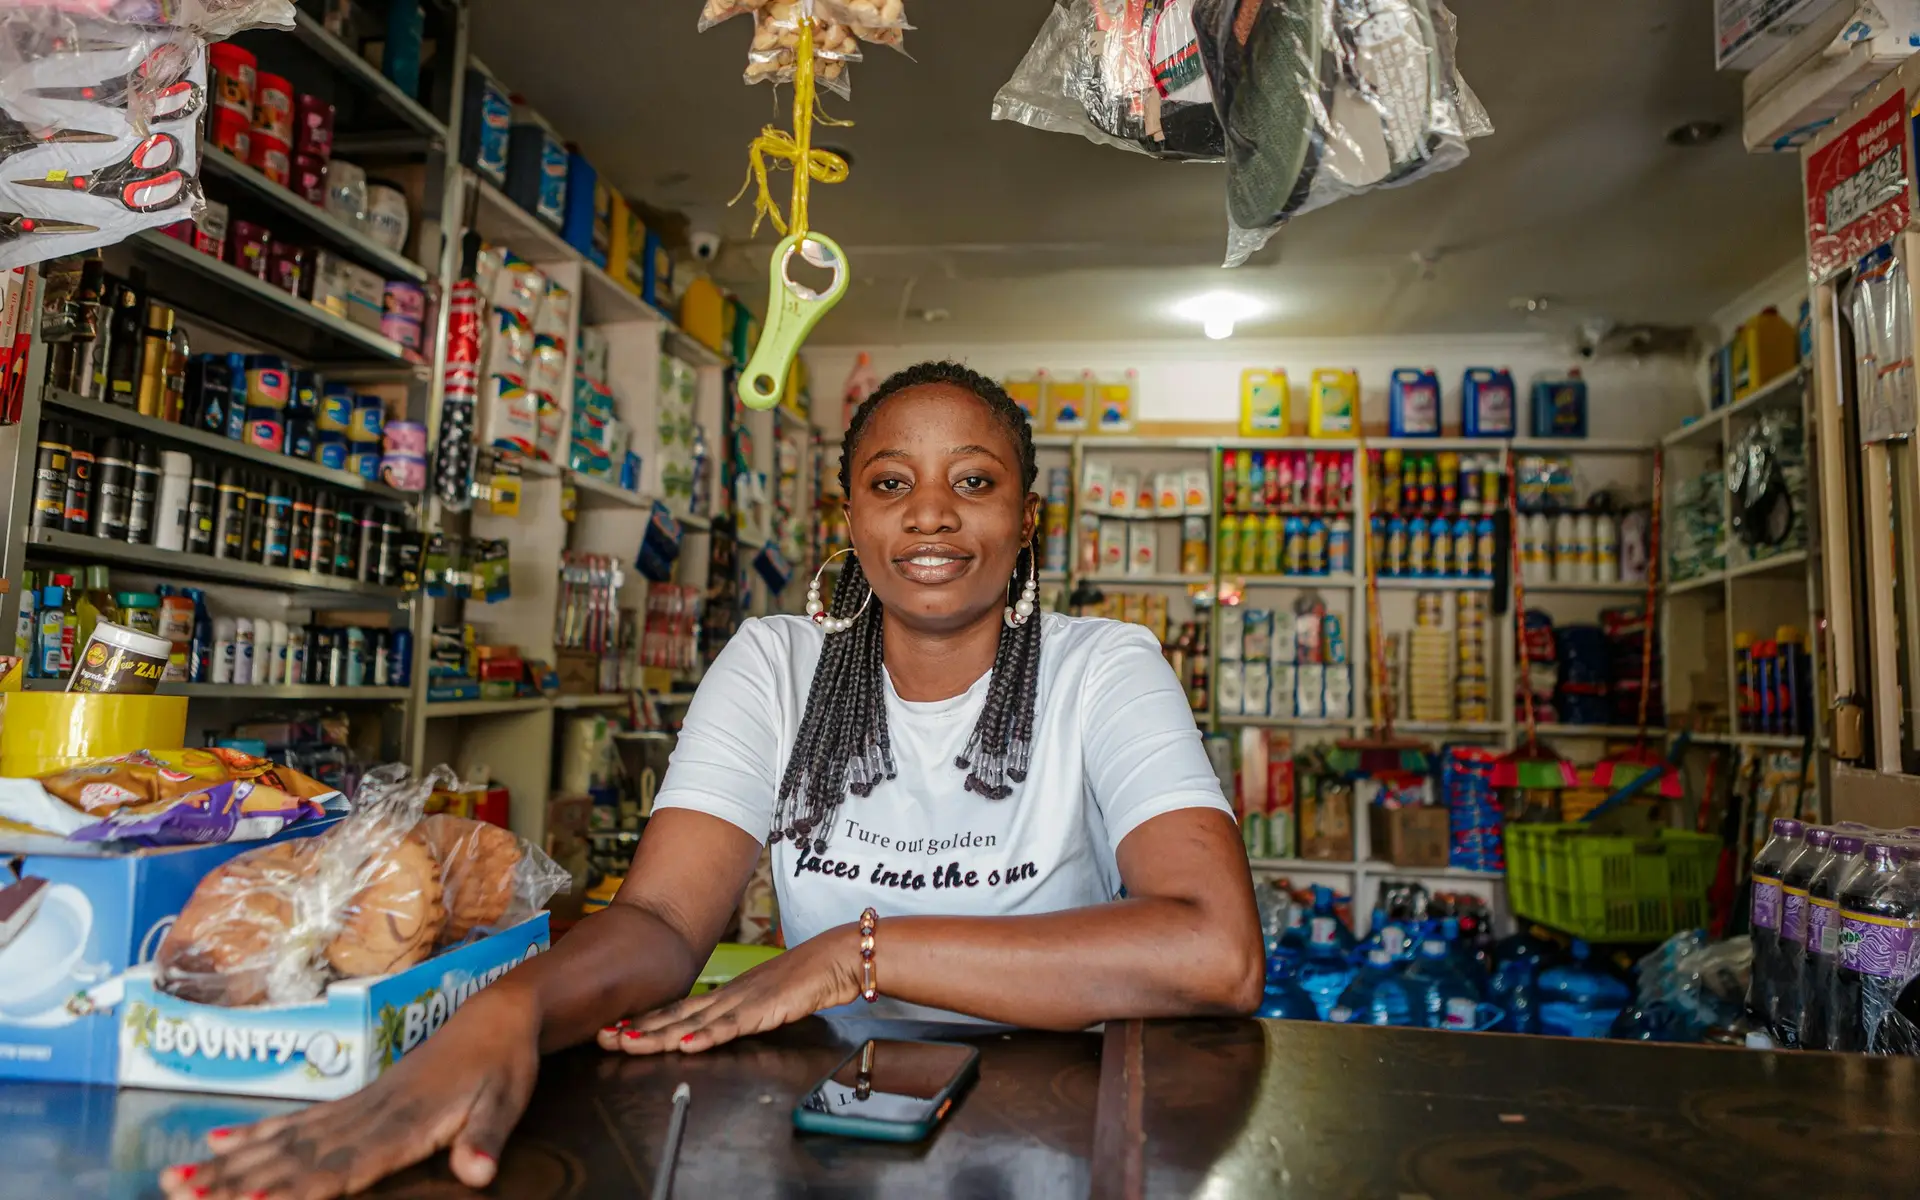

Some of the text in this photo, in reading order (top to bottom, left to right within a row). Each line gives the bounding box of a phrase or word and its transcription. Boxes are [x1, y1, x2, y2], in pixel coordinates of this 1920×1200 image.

[845, 819, 891, 848] Ture
[926, 831, 997, 856] golden
[794, 848, 860, 880] faces
[870, 862, 926, 890] into
[932, 861, 980, 889] the
[155, 1019, 299, 1064] BOUNTY
